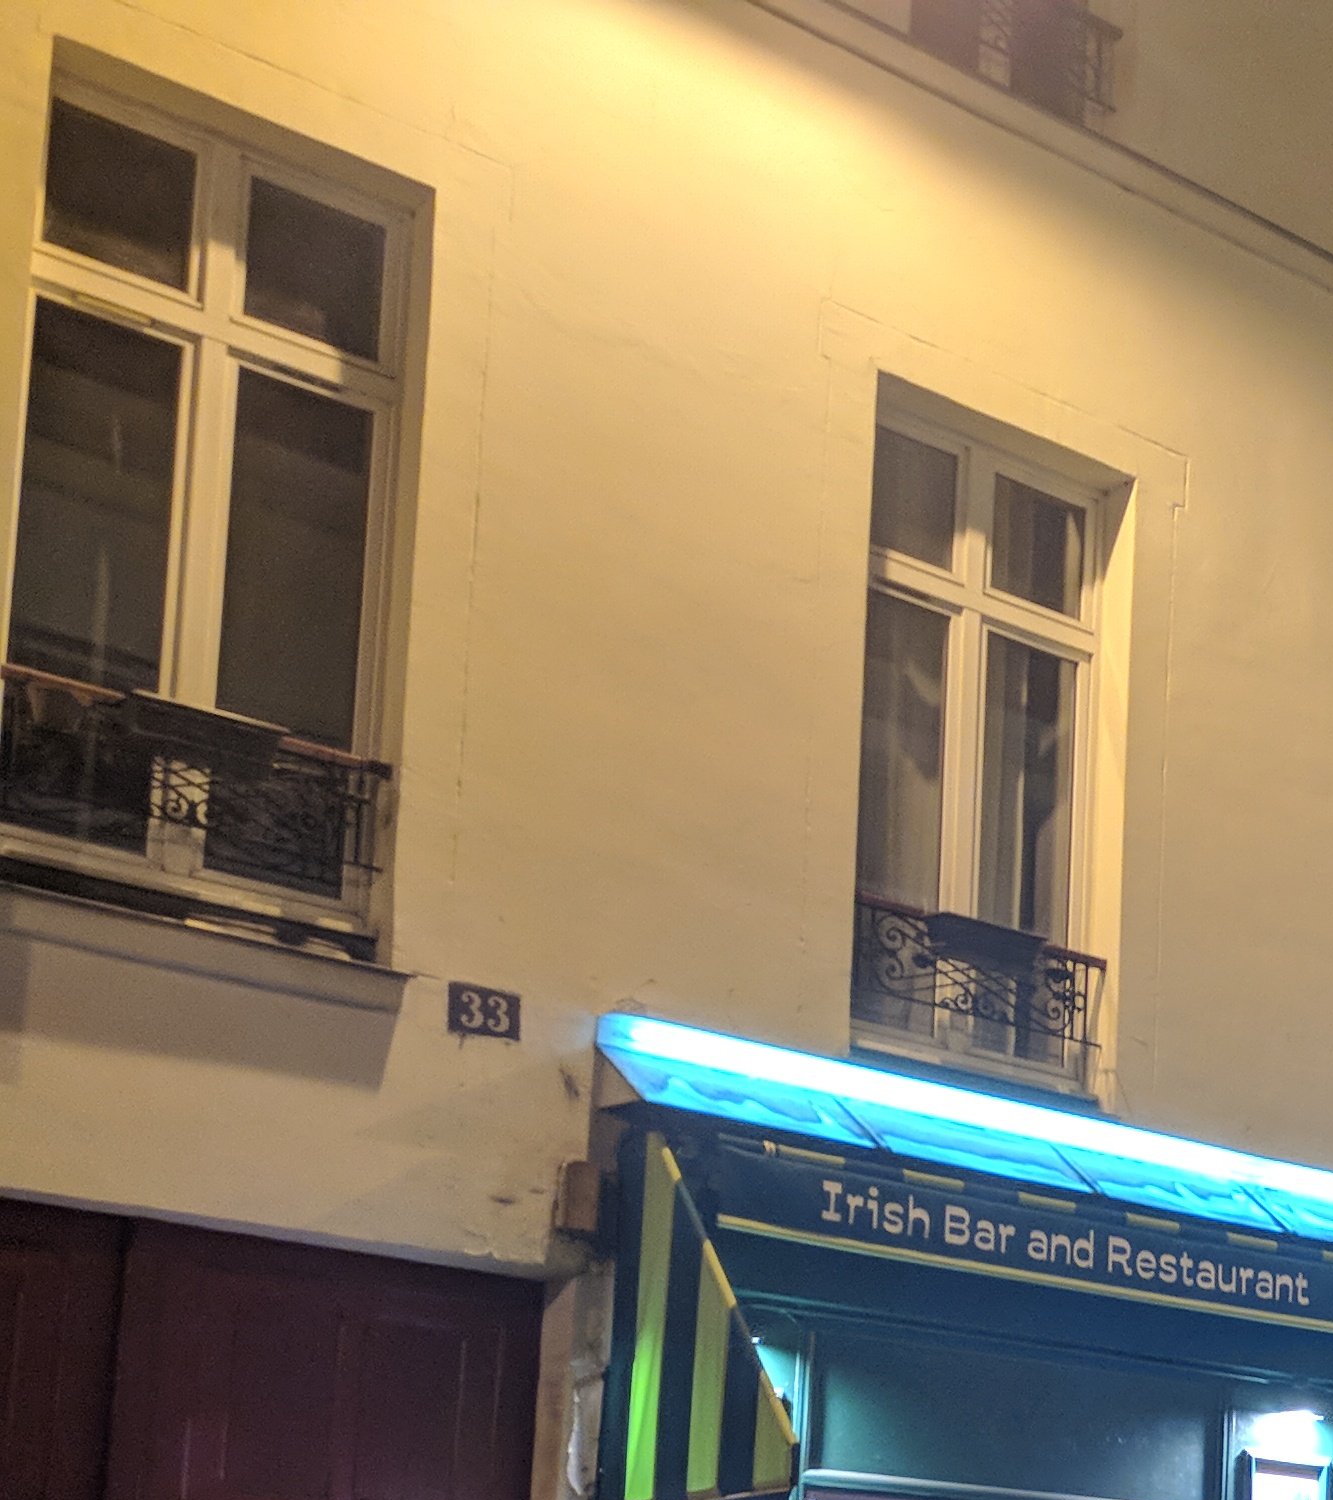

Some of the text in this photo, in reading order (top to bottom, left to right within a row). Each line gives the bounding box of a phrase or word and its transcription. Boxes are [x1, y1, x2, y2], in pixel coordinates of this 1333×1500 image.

[461, 990, 510, 1033] 33
[821, 1179, 1310, 1306] Irish Bar and Restaurant
